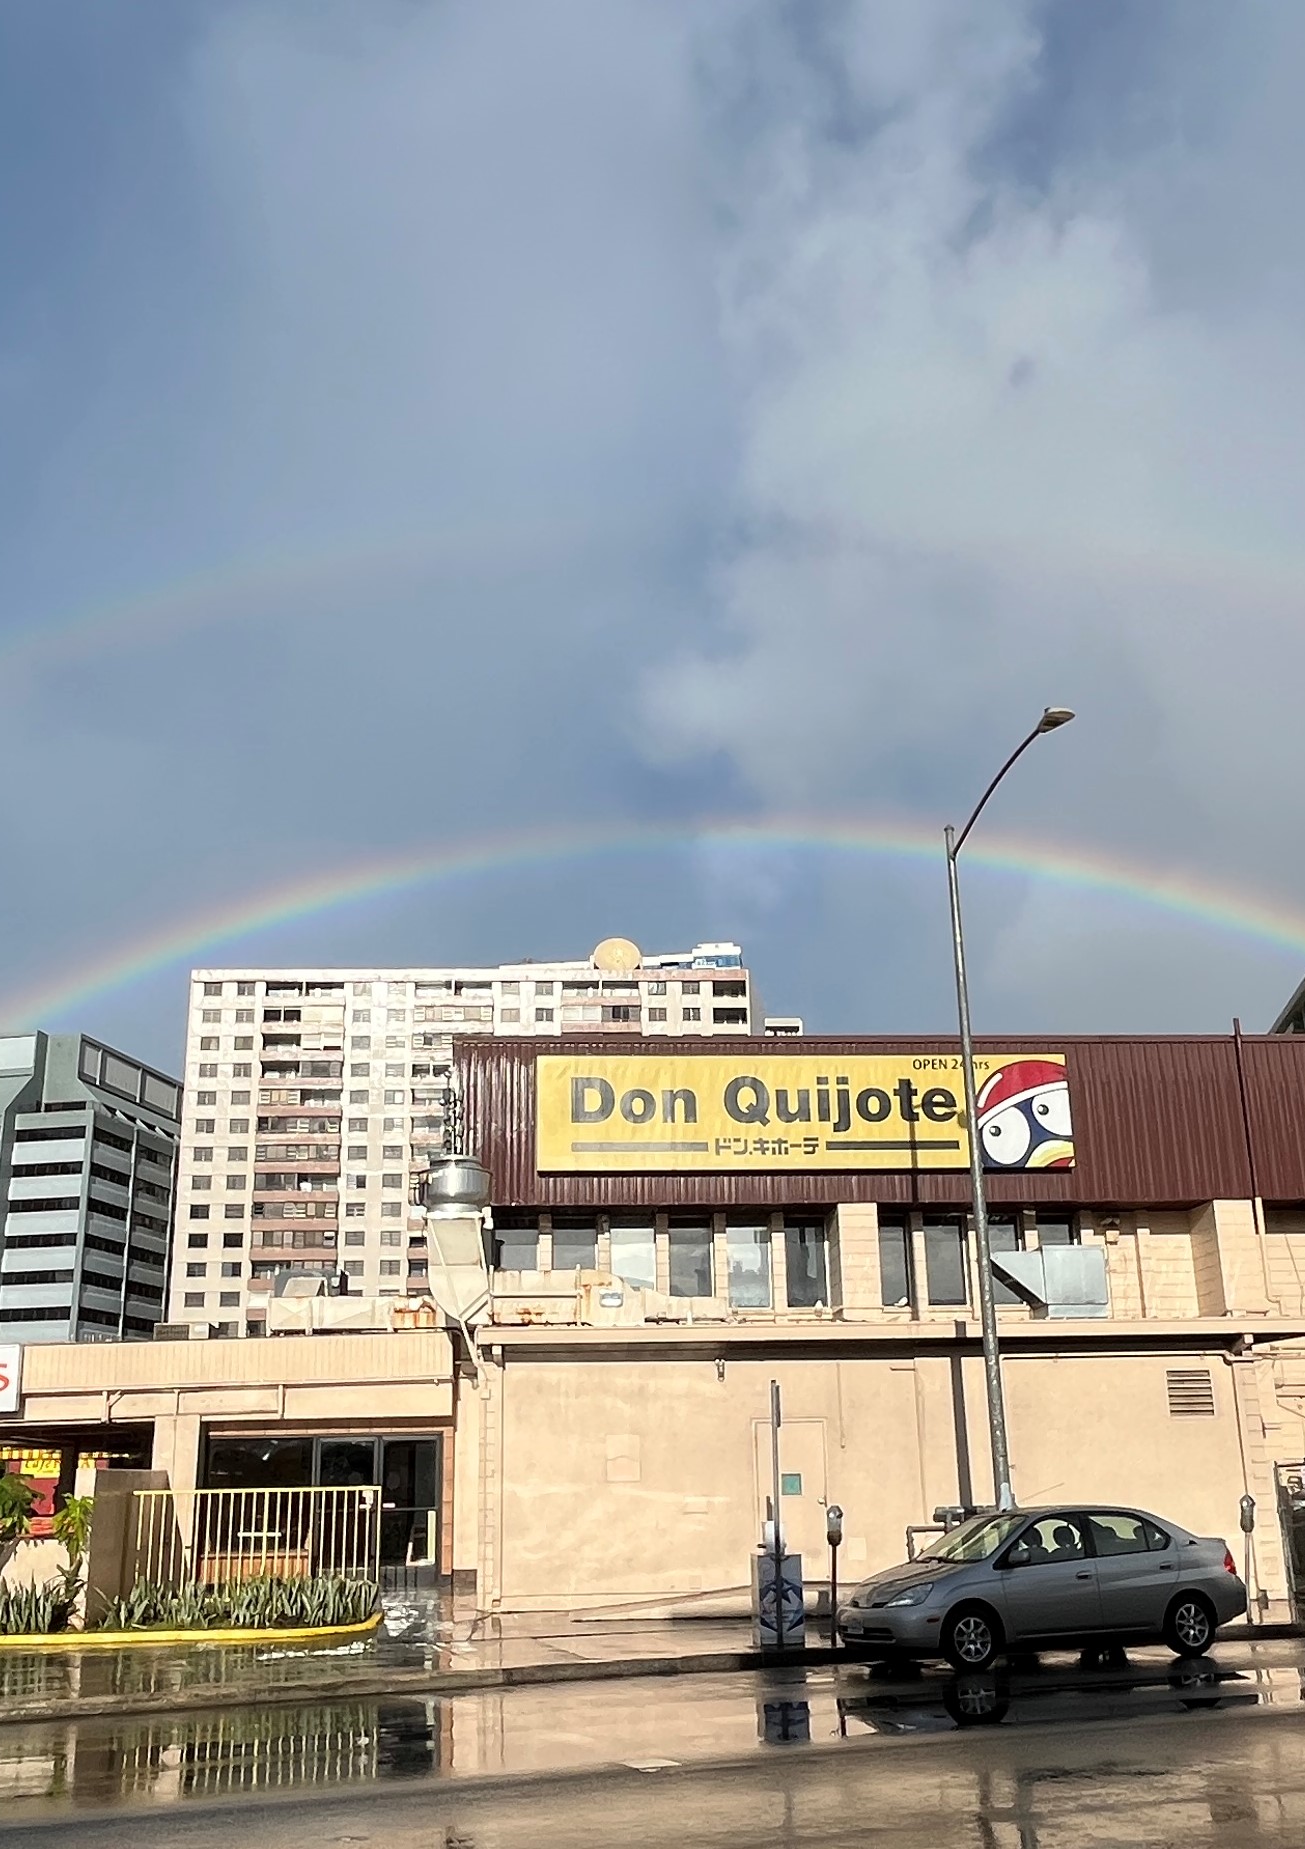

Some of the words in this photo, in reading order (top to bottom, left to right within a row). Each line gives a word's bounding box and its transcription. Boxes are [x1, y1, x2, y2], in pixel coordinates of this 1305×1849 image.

[912, 1058, 948, 1070] OPEN
[571, 1076, 698, 1124] Don
[724, 1075, 958, 1133] Quijote
